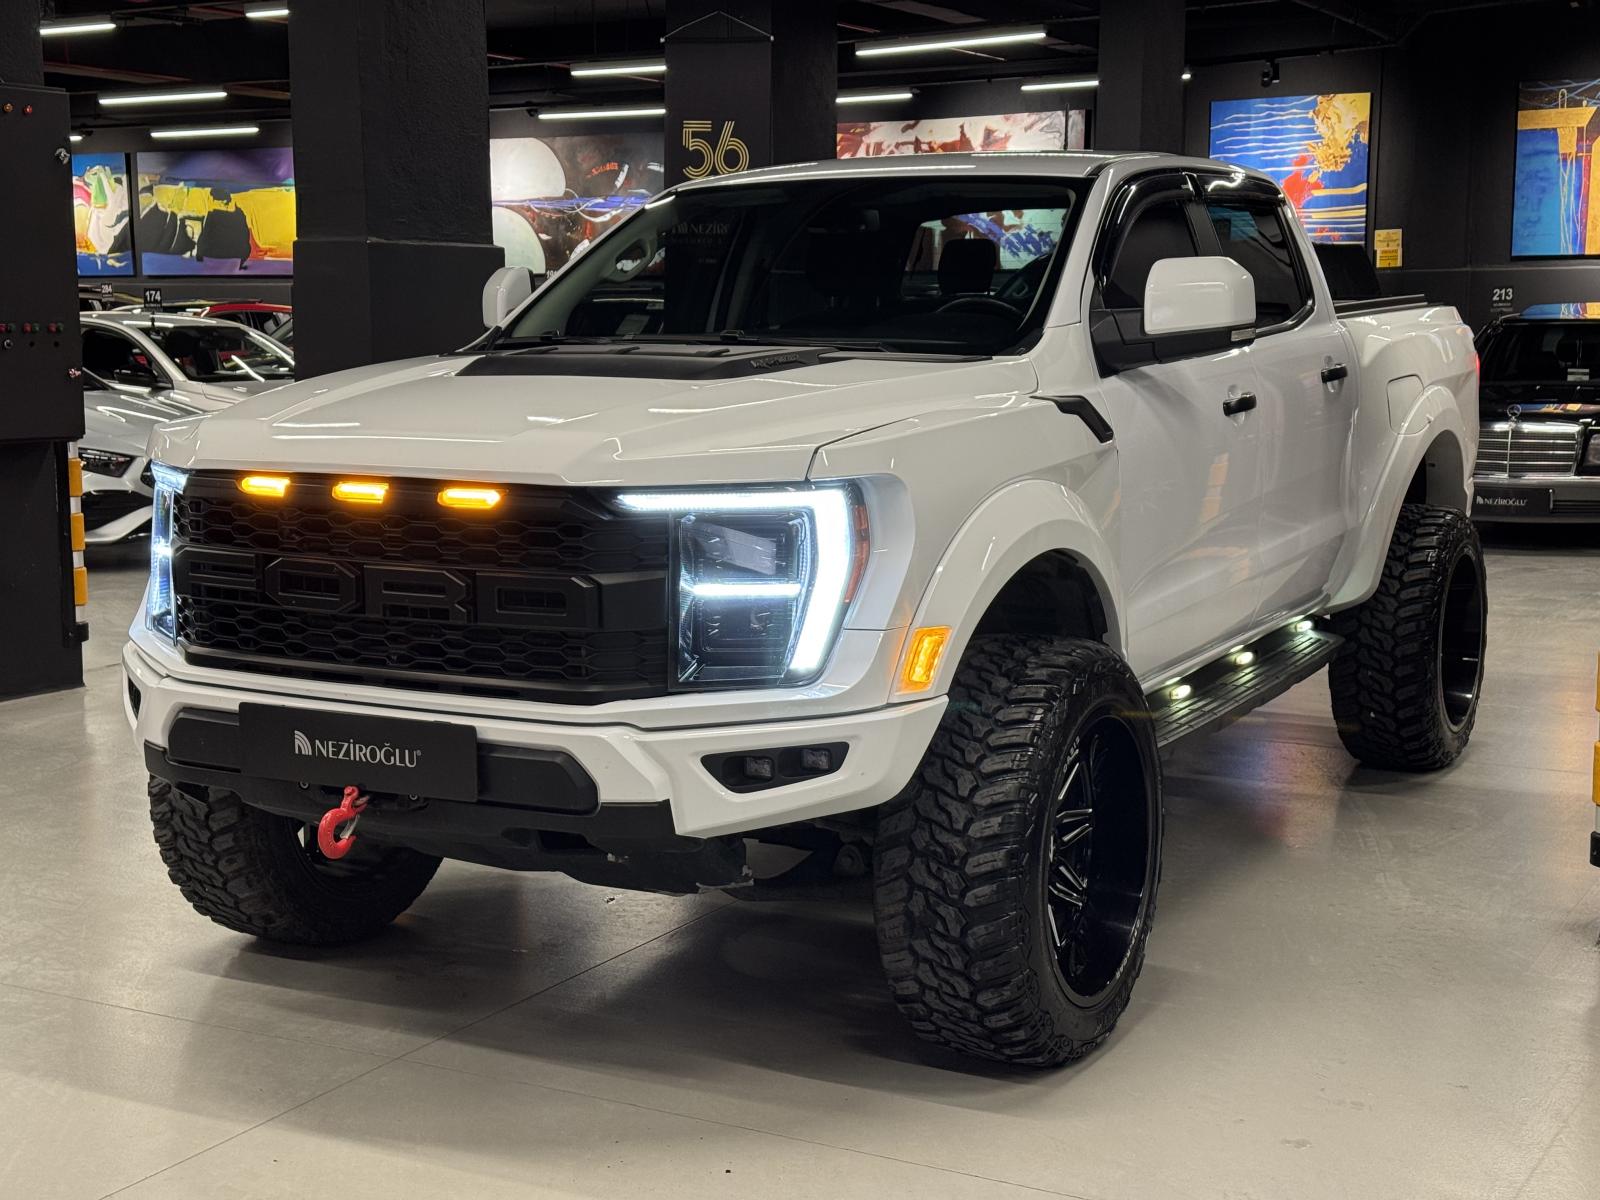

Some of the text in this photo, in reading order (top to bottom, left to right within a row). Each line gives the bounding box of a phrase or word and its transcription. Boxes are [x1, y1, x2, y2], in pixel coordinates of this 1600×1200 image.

[682, 120, 749, 180] 56
[145, 290, 161, 302] 174
[1492, 288, 1513, 301] 213
[175, 545, 598, 631] FORD
[314, 738, 417, 768] NEZİROĞLU
